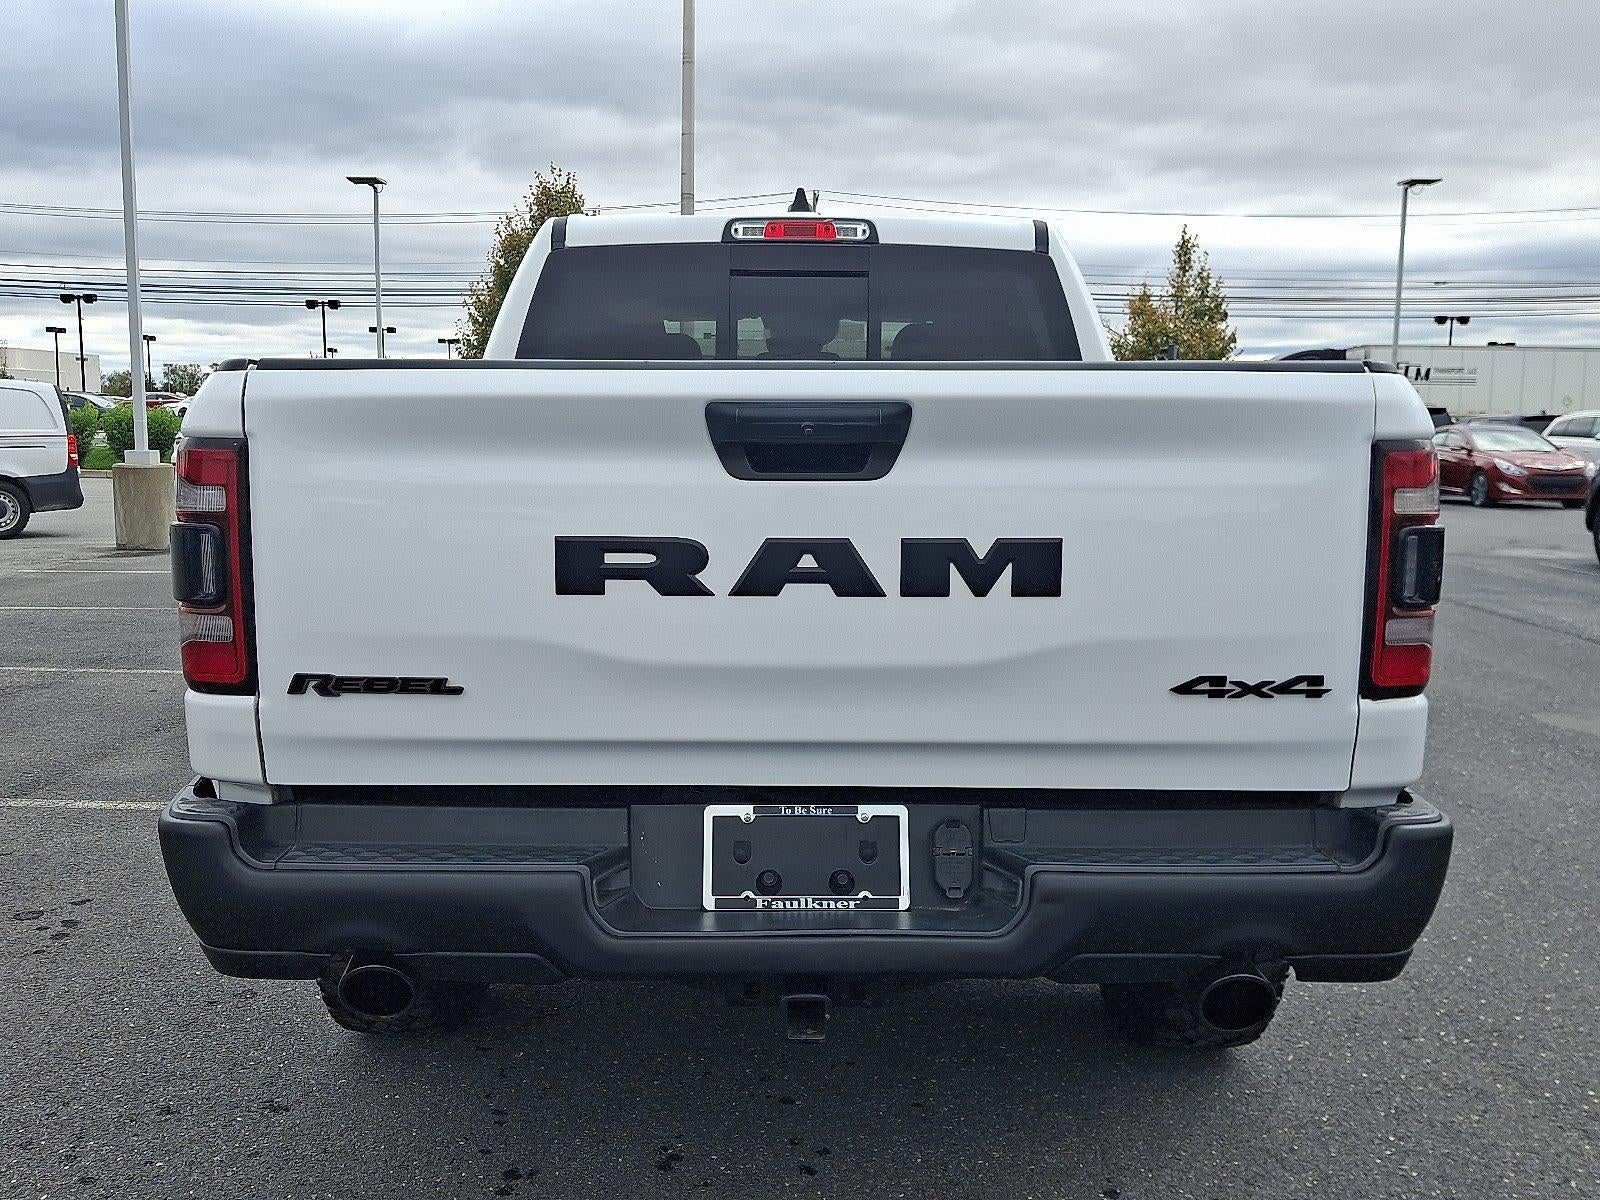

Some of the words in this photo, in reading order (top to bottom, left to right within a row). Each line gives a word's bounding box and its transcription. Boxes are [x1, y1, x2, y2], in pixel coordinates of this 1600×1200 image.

[554, 535, 1064, 598] RAM
[287, 672, 465, 698] REBEL
[779, 806, 792, 815] To
[794, 806, 808, 815] Be
[809, 805, 833, 815] Sure
[755, 897, 861, 909] Faulkner
